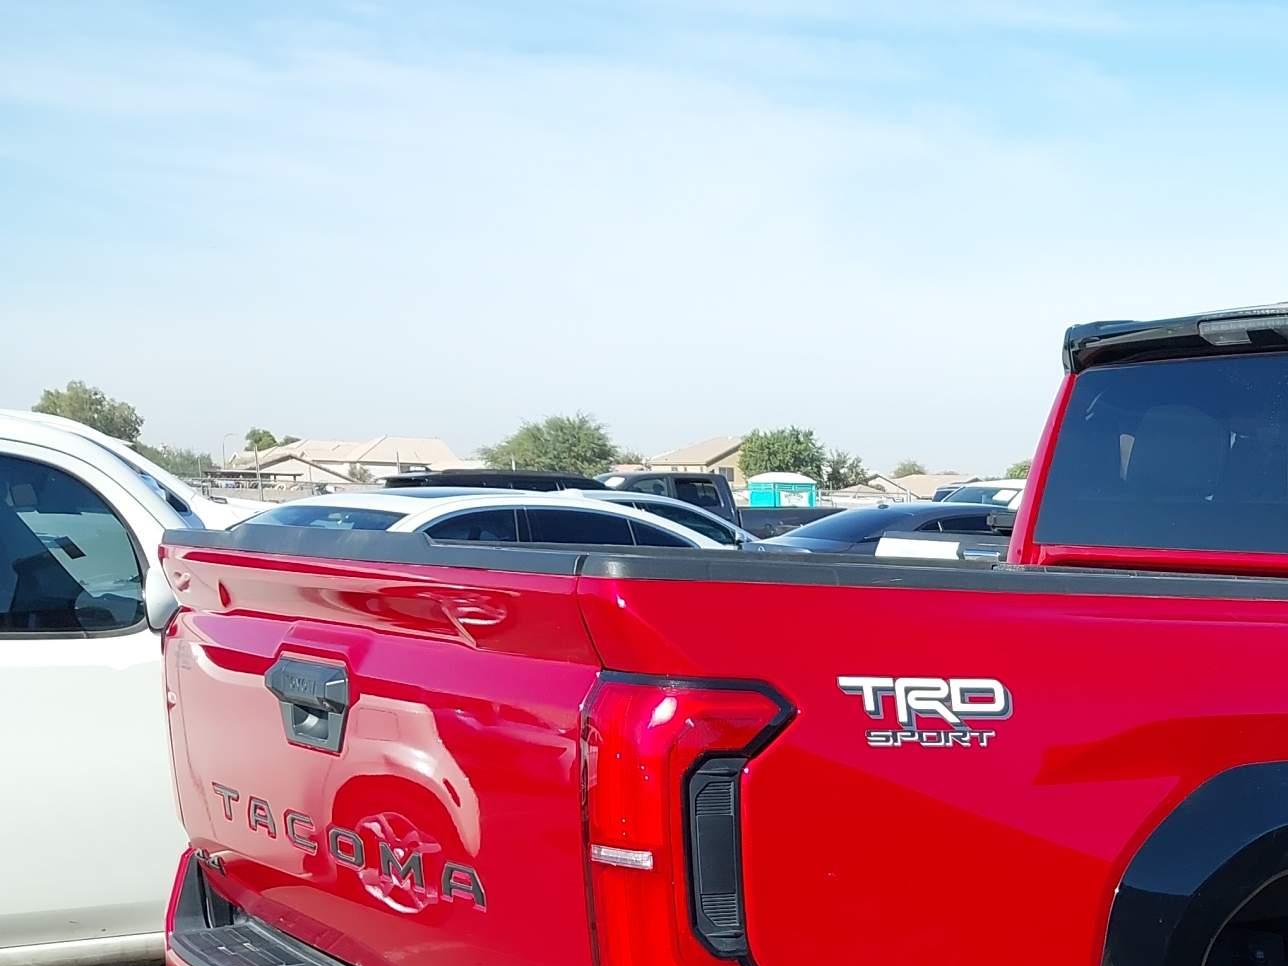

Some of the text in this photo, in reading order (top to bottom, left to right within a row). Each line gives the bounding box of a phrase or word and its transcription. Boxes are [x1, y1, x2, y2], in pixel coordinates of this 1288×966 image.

[837, 676, 1013, 731] TRD
[866, 729, 996, 747] SPORT
[212, 781, 487, 912] TACOMA
